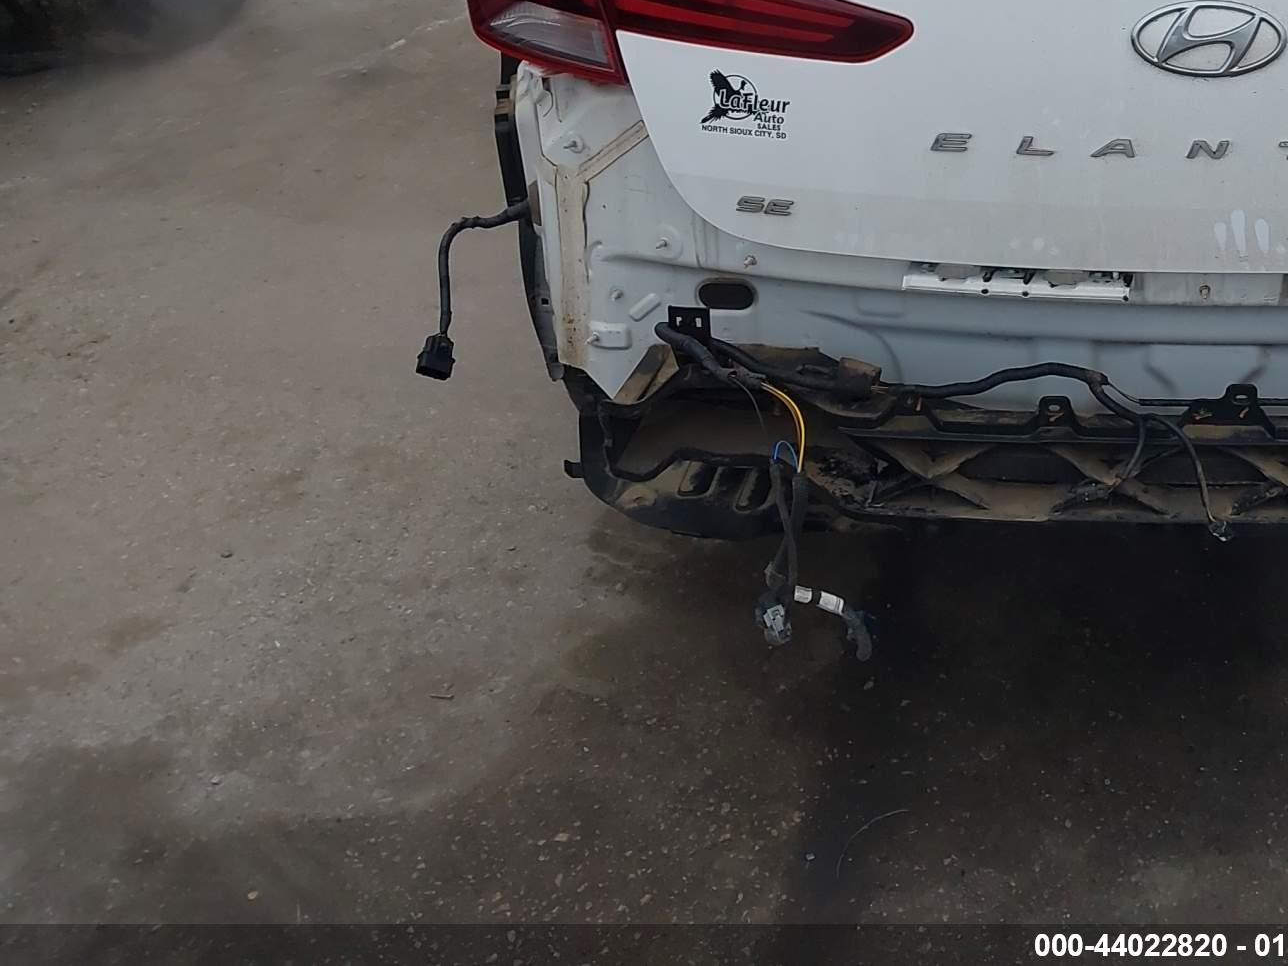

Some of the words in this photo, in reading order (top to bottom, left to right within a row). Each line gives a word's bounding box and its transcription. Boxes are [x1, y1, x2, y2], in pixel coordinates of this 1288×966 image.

[720, 90, 790, 113] LaFleur
[753, 112, 785, 124] Auto
[701, 125, 728, 133] NORTH
[730, 127, 752, 136] SIOUX
[757, 123, 781, 131] SALES
[736, 195, 794, 216] SE
